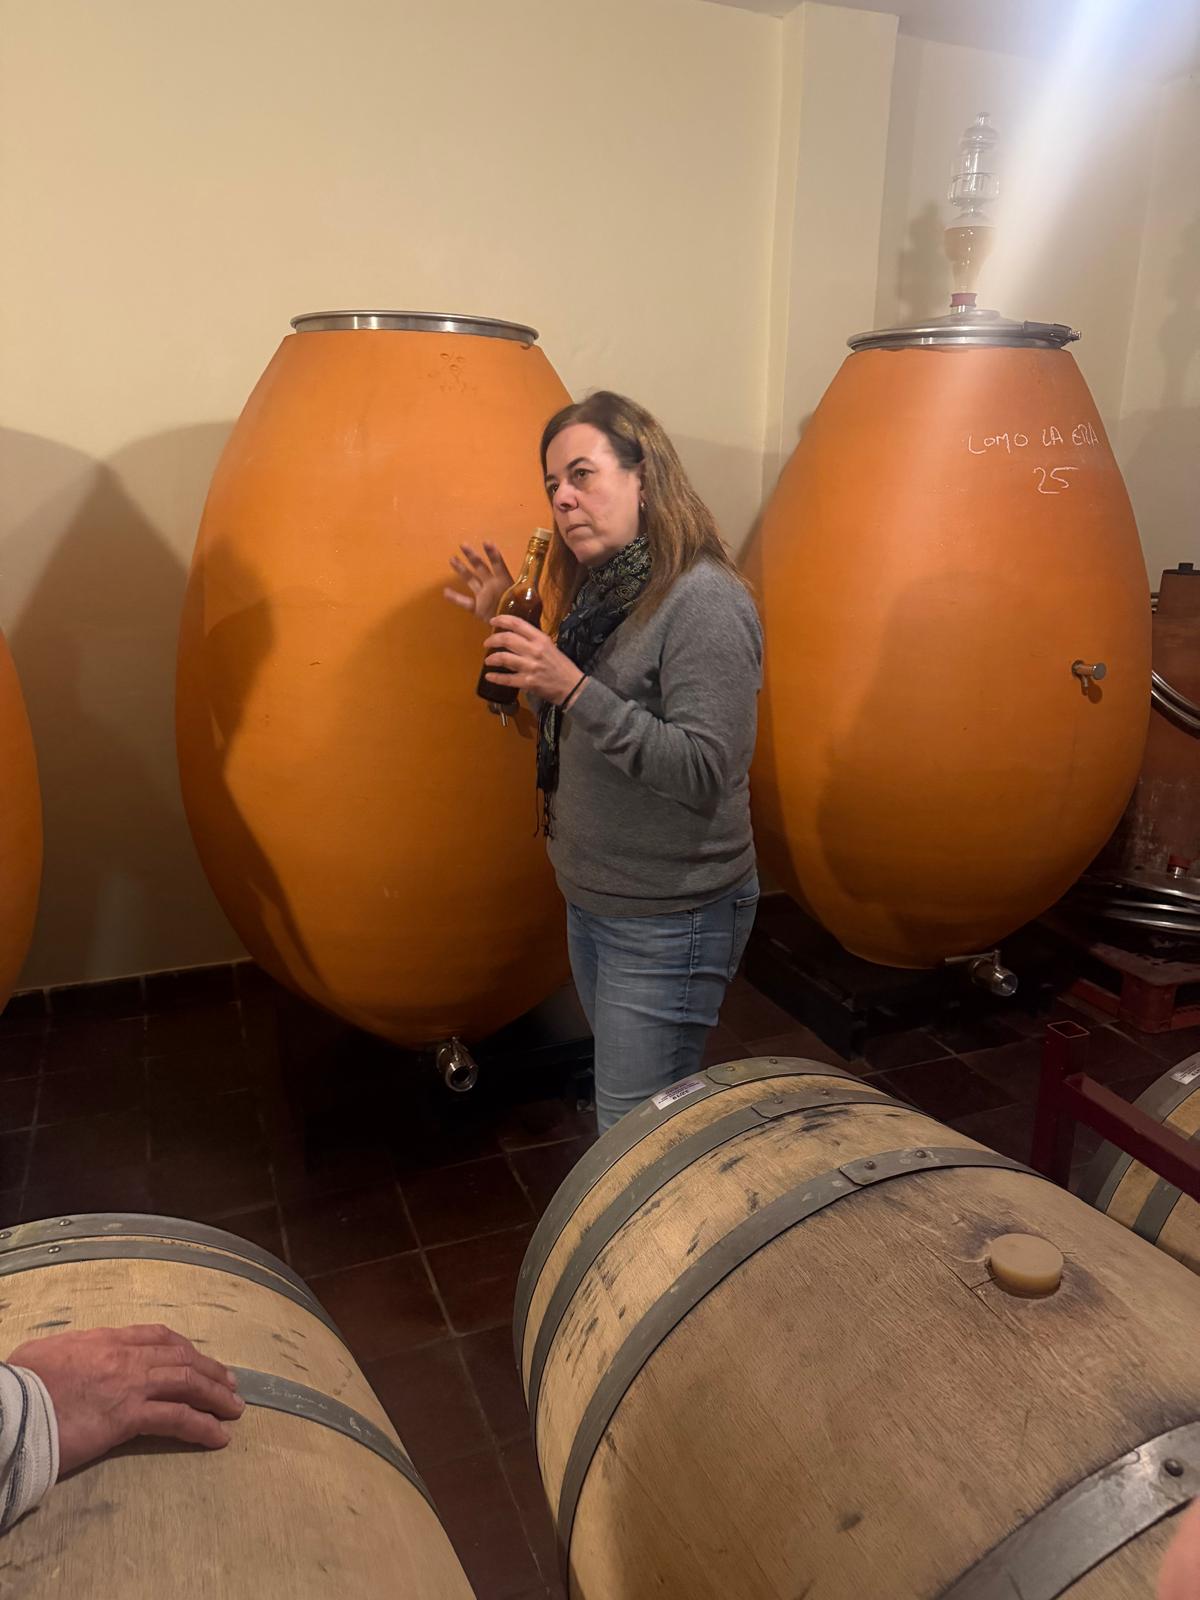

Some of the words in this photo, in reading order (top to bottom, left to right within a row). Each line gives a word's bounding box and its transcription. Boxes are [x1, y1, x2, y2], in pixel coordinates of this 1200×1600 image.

[968, 432, 1029, 454] LOMO
[1042, 425, 1064, 447] LA
[1032, 466, 1080, 495] 25
